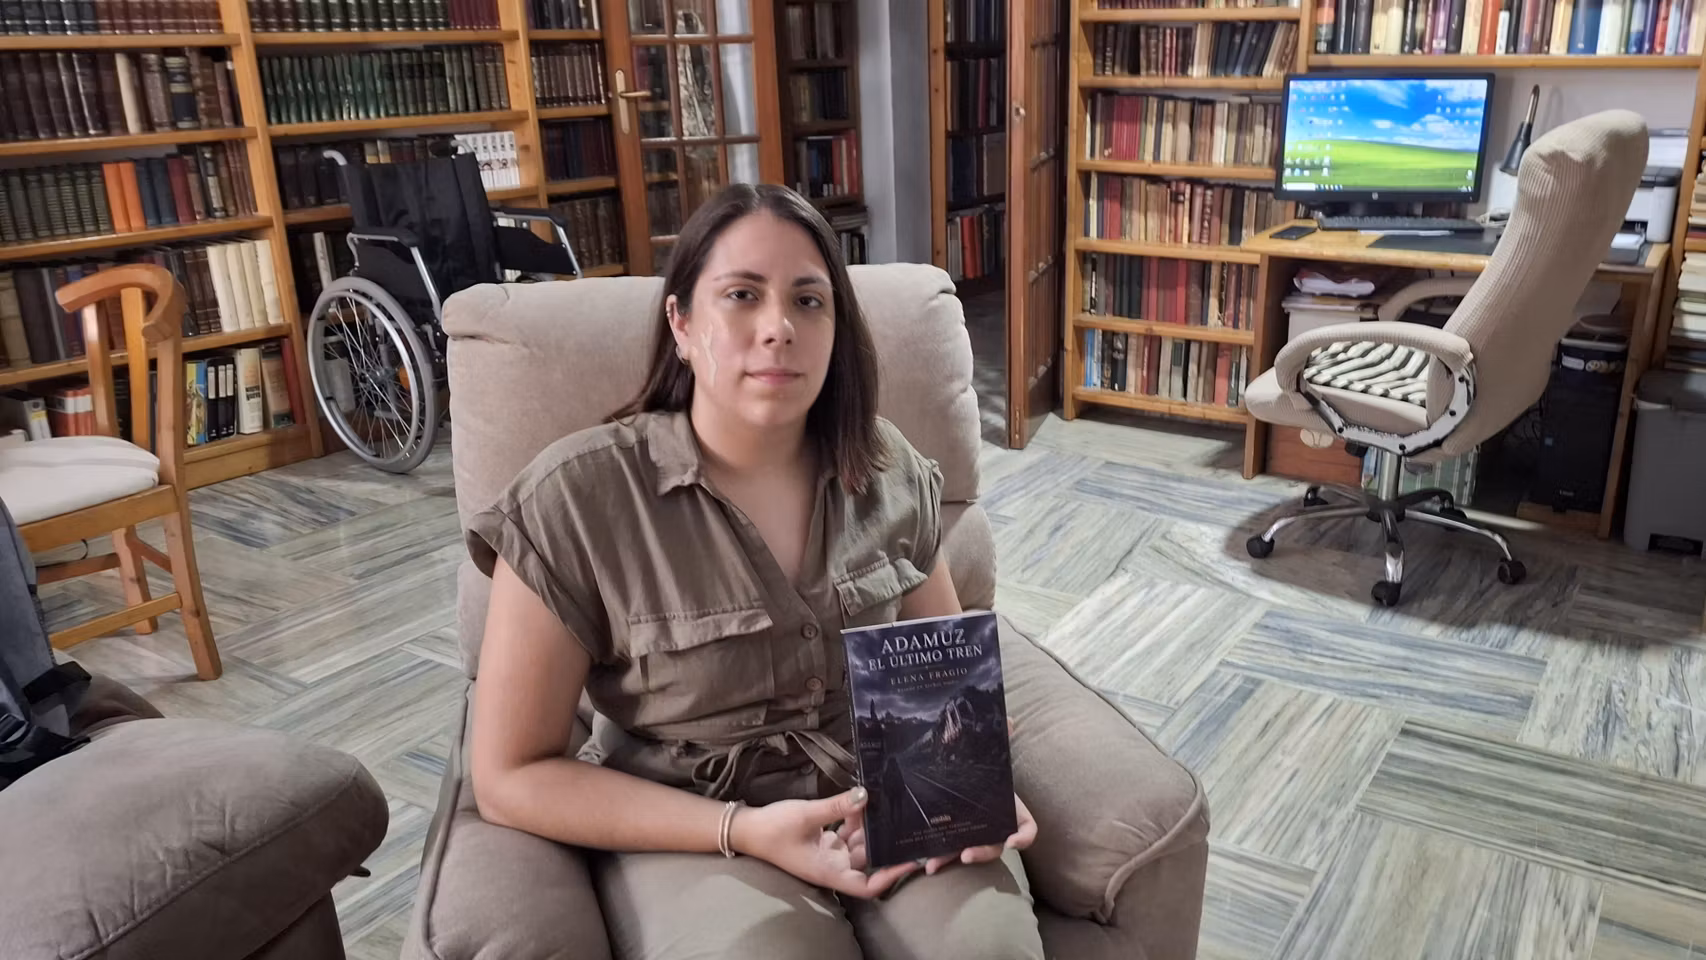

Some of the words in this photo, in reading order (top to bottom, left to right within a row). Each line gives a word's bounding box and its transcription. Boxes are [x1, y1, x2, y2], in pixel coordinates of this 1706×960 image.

[881, 628, 966, 654] ADAMUZ
[868, 658, 886, 672] EL
[946, 644, 983, 660] TREN
[890, 673, 924, 686] ELENA
[928, 667, 968, 680] FRAGIO
